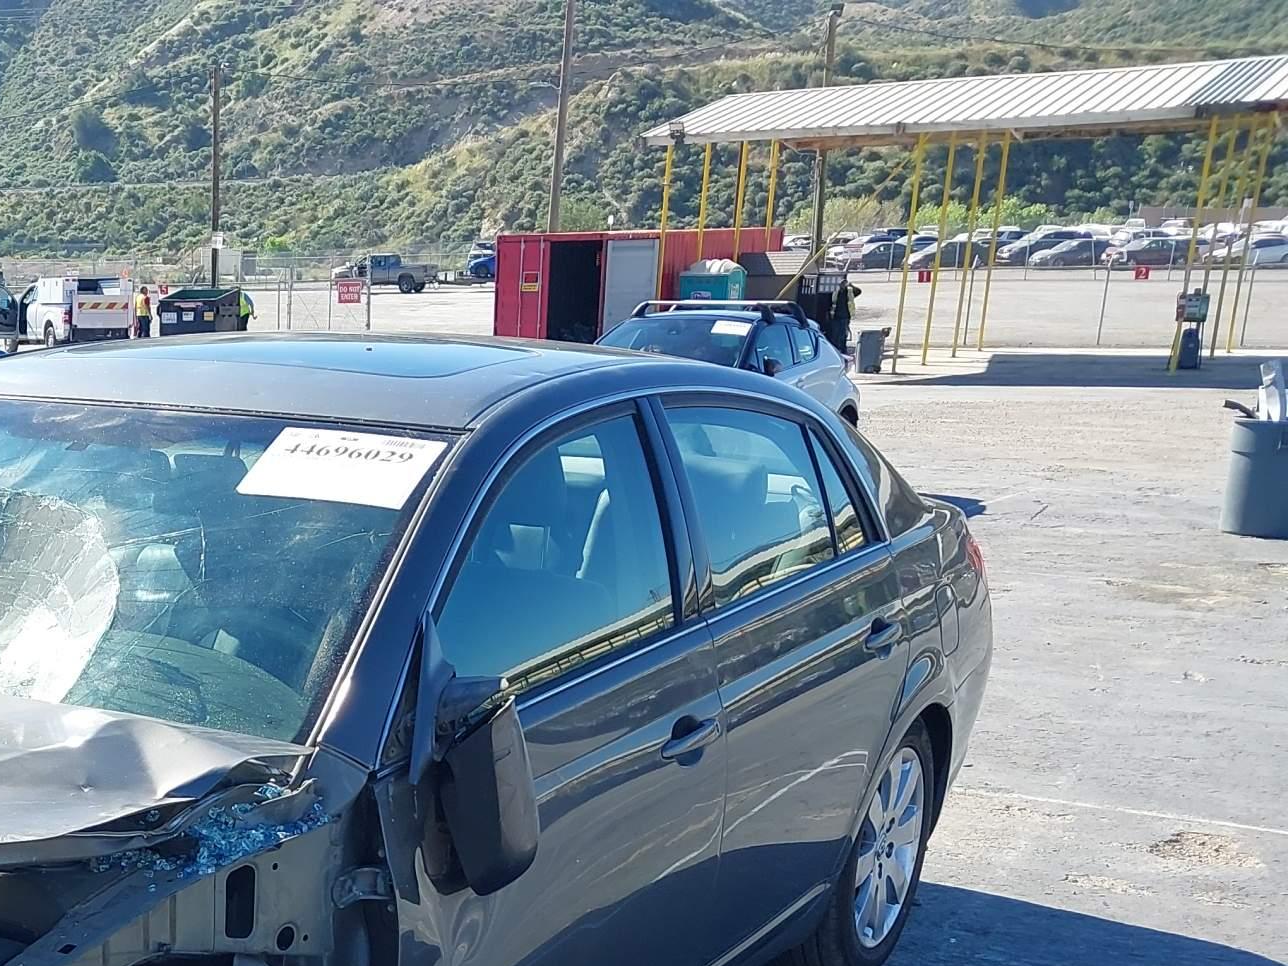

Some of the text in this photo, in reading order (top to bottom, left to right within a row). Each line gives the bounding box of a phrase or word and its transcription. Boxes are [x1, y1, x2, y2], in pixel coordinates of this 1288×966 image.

[1137, 267, 1147, 278] 2
[339, 285, 361, 294] DO NOT
[340, 293, 359, 301] ENTER
[284, 442, 414, 464] 44696029
